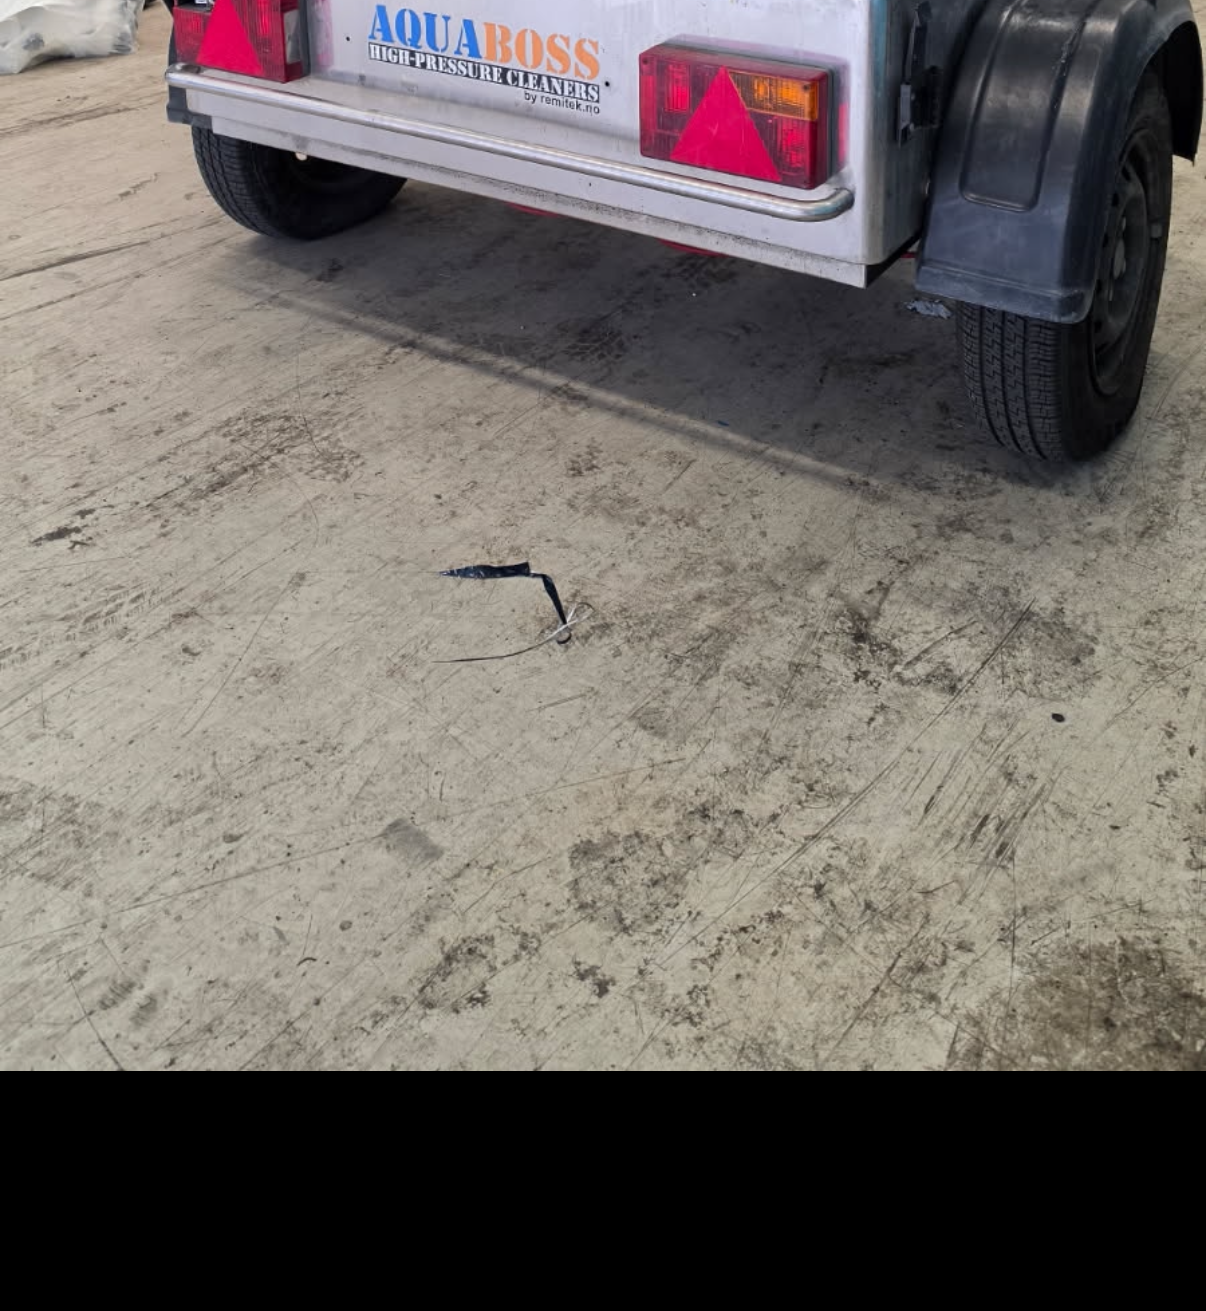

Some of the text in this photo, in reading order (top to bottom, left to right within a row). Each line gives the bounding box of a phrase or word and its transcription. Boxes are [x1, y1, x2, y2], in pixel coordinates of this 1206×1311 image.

[368, 4, 600, 80] AQUABOSS
[369, 43, 599, 103] HIGH-PRESSURE CLEANERS
[524, 91, 600, 115] by remitek.no
